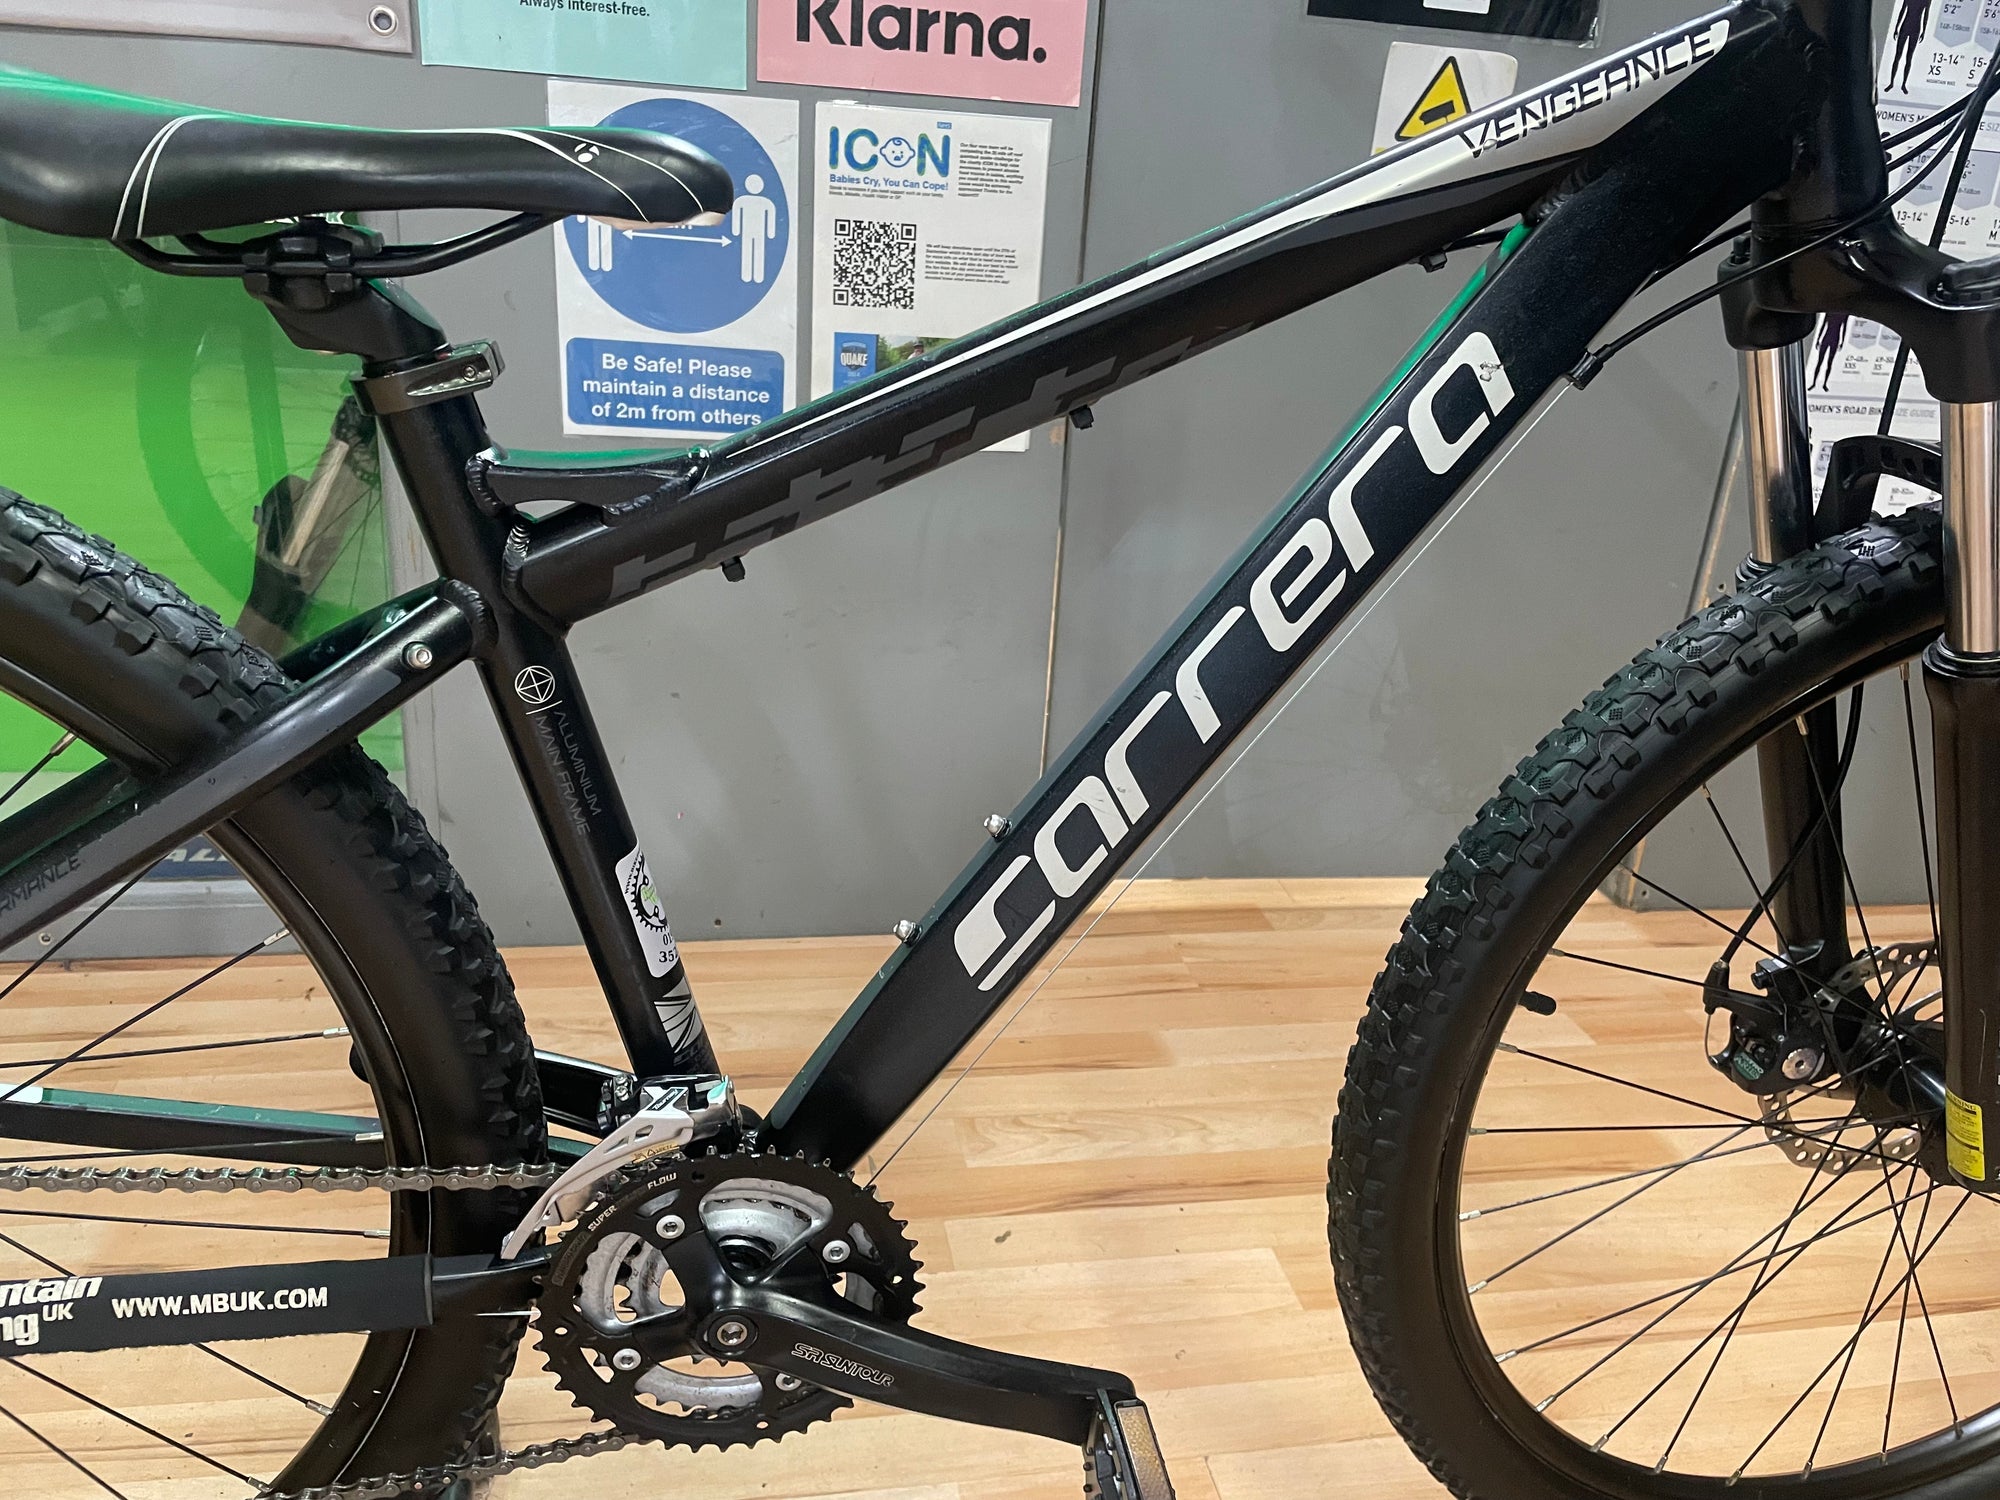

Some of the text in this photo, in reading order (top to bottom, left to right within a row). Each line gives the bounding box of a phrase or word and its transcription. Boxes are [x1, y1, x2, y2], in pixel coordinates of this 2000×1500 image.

[796, 0, 1047, 63] Klarna.
[1928, 65, 1941, 76] XS
[1967, 69, 1976, 80] S
[1459, 26, 1720, 158] VENGEANCE
[829, 173, 861, 184] Babies
[862, 176, 881, 188] Cry,
[883, 177, 900, 187] You
[902, 179, 920, 189] Can
[922, 180, 949, 192] Cope!
[602, 353, 752, 379] Be Safe! Please
[840, 352, 868, 367] QUAKE
[582, 378, 770, 403] maintain a distance
[591, 402, 762, 426] of 2m from others
[1842, 405, 1867, 415] ROAD
[954, 331, 1516, 991] carrera
[535, 716, 591, 835] MAIN FRAME
[554, 711, 602, 816] ALUMINIUM
[587, 1172, 677, 1232] SUPER FLOW
[42, 1302, 74, 1322] UK
[111, 1286, 328, 1320] WWW.MBUK.COM
[820, 1352, 895, 1387] SUNTOUR
